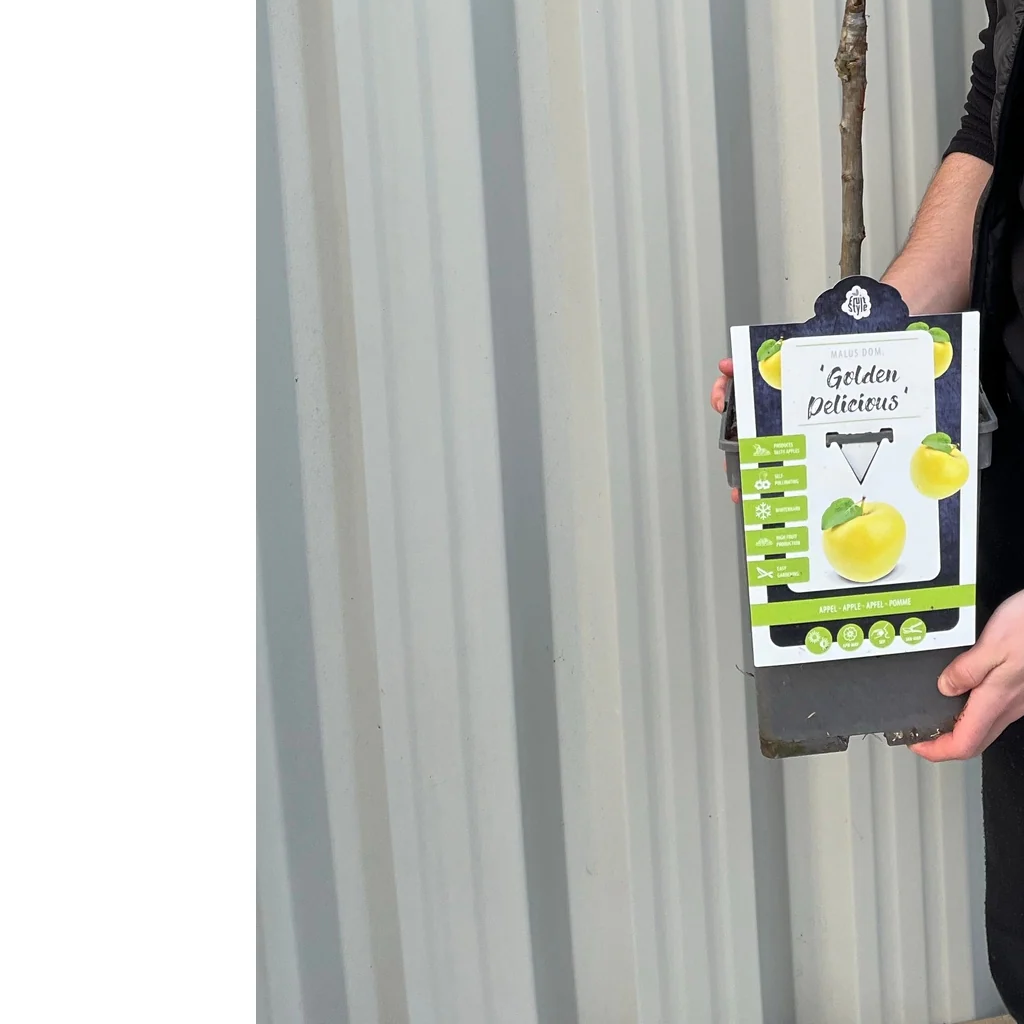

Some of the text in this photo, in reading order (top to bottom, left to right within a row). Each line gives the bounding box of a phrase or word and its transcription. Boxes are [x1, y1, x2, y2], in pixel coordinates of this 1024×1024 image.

[830, 347, 885, 359] MALUS DOM.
[819, 605, 838, 615] APPEL
[842, 602, 861, 612] APPLE
[866, 600, 884, 610] APFEL
[888, 597, 911, 607] POMME
